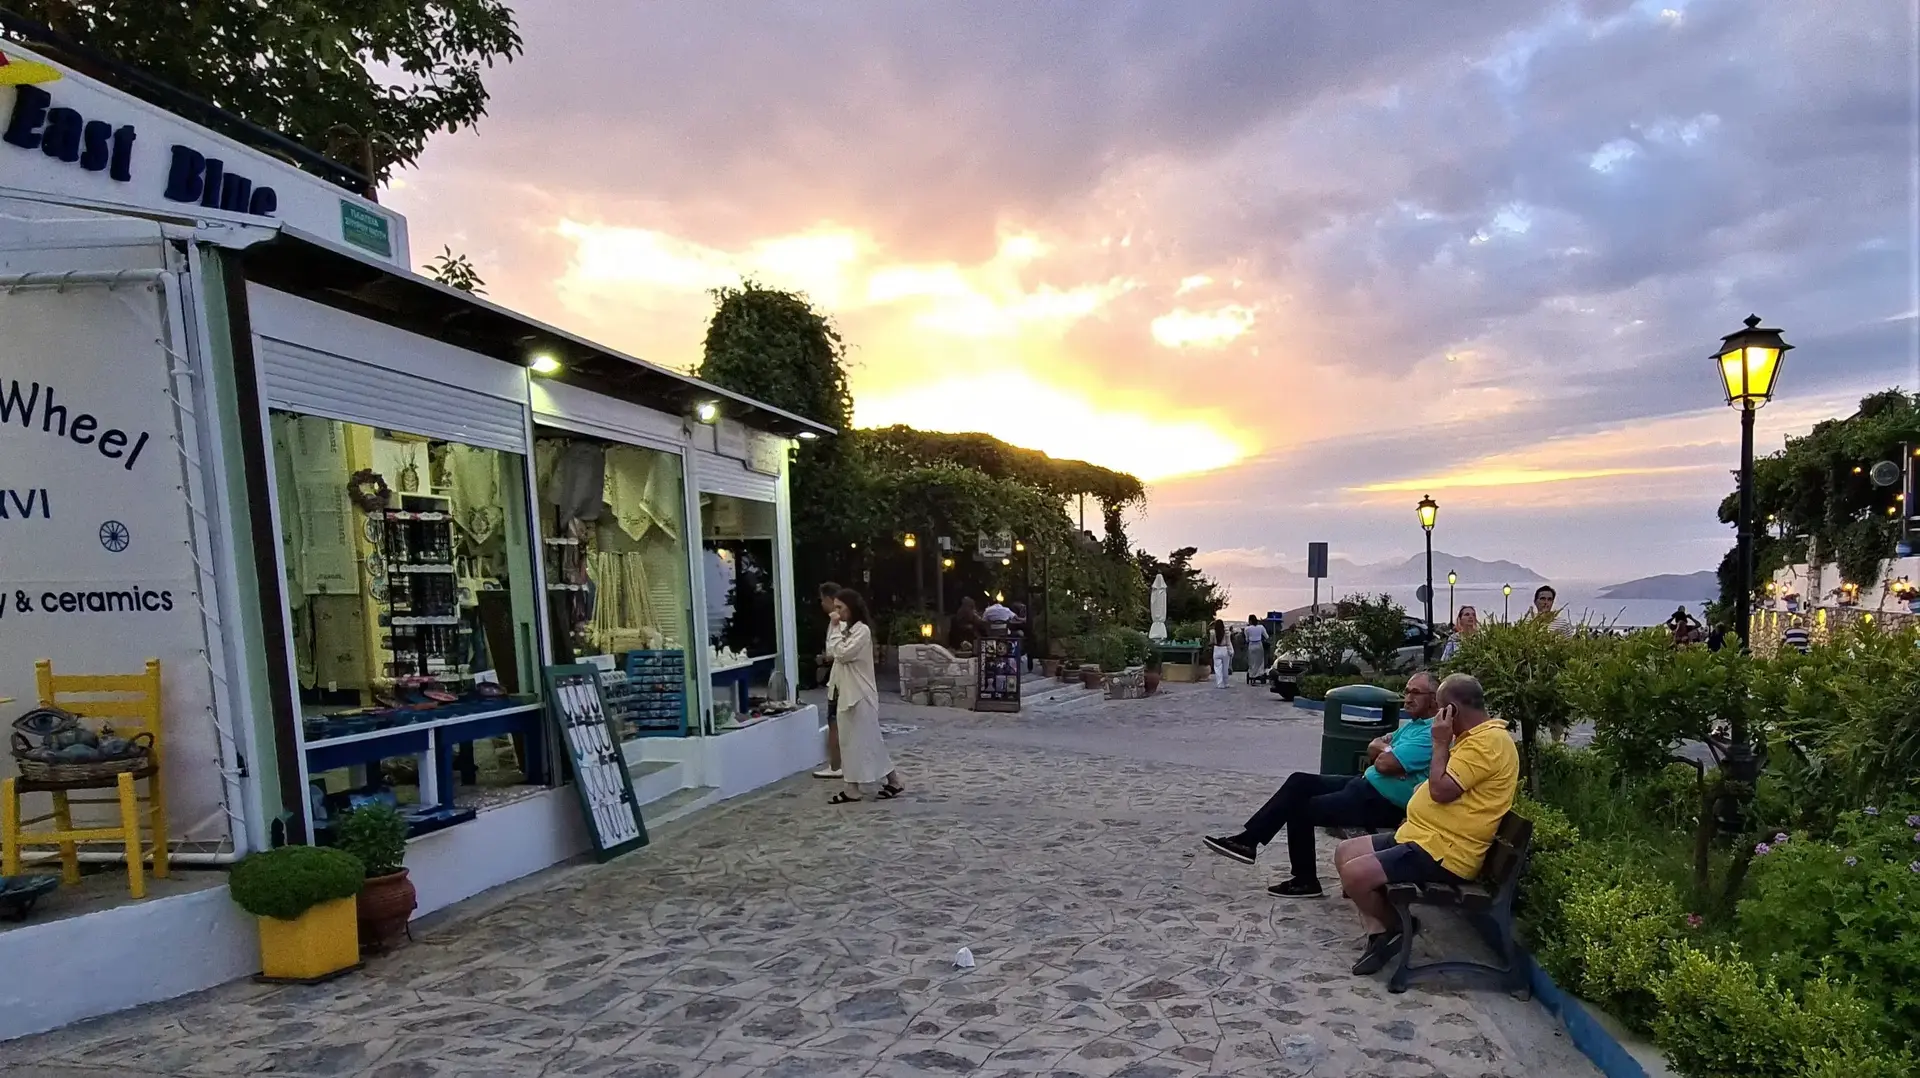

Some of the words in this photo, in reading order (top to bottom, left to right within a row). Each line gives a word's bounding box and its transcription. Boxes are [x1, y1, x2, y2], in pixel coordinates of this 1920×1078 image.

[4, 84, 137, 182] East
[163, 144, 278, 218] Blue
[0, 378, 149, 471] Wheel
[15, 589, 34, 613] &
[41, 586, 173, 613] ceramics
